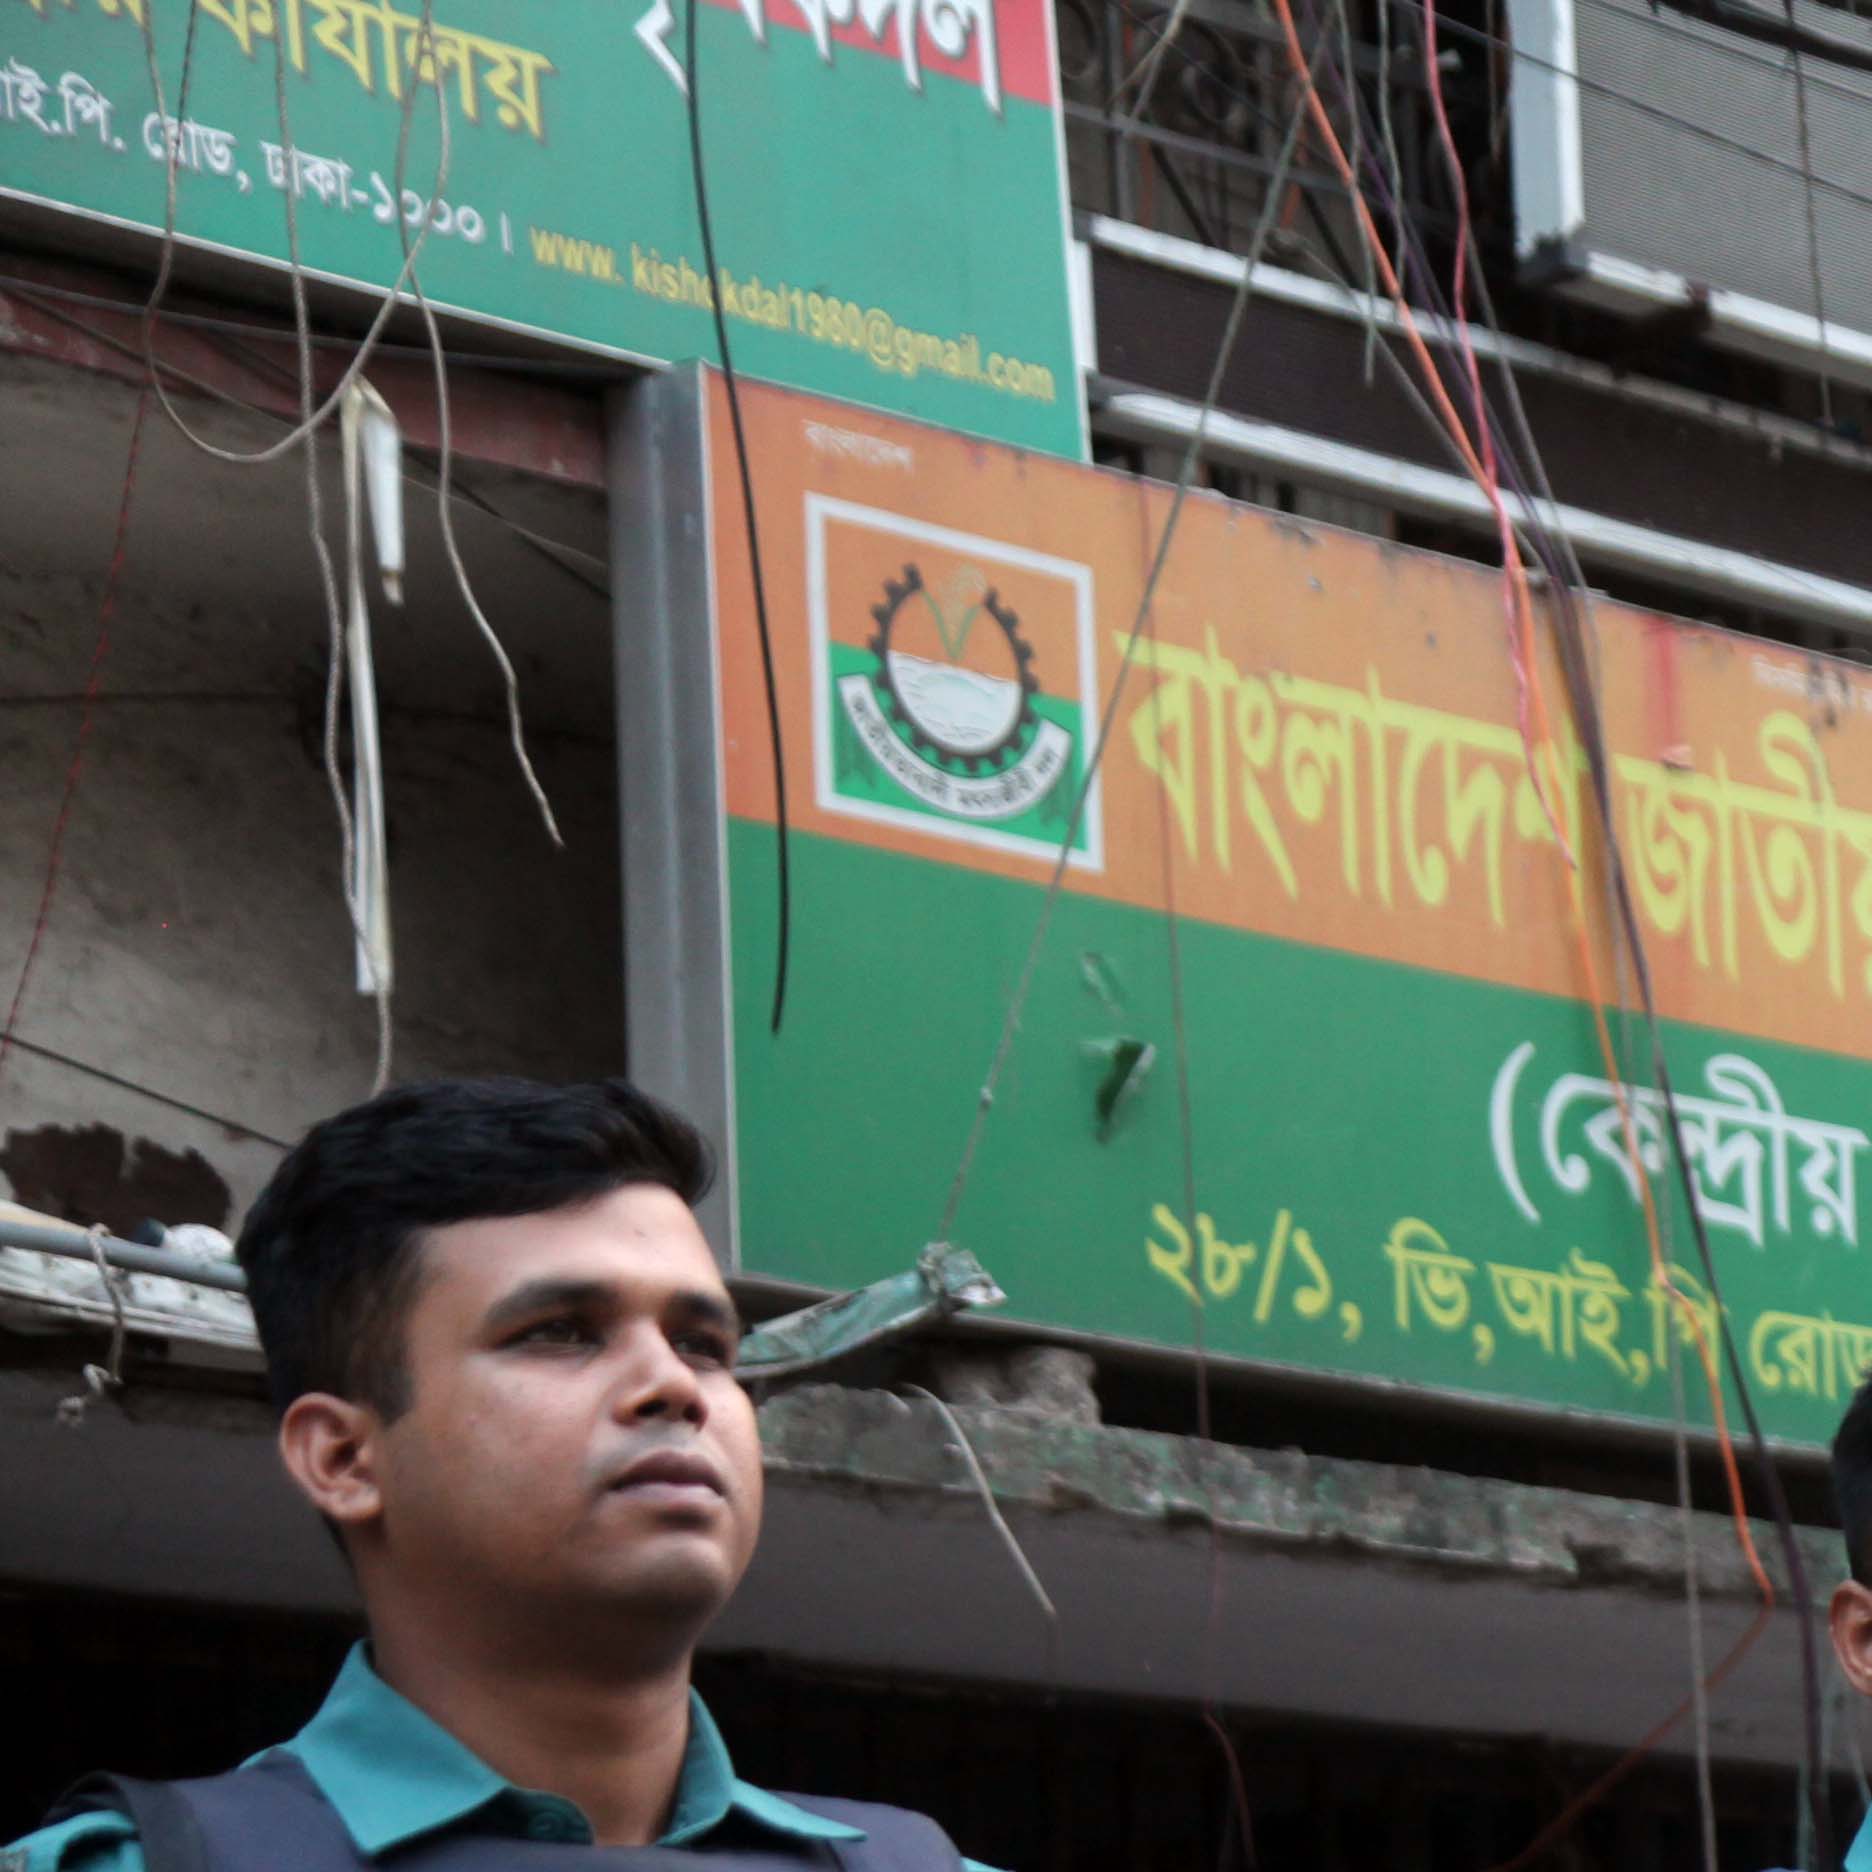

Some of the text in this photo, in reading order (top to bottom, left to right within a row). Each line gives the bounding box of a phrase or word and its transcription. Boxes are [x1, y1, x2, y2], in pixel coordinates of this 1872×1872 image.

[1113, 626, 1590, 930] বাংলাদেশ
[1490, 1041, 1871, 1250] (কেন্দ্রীয়
[1146, 1202, 1363, 1342] ২৮/১,
